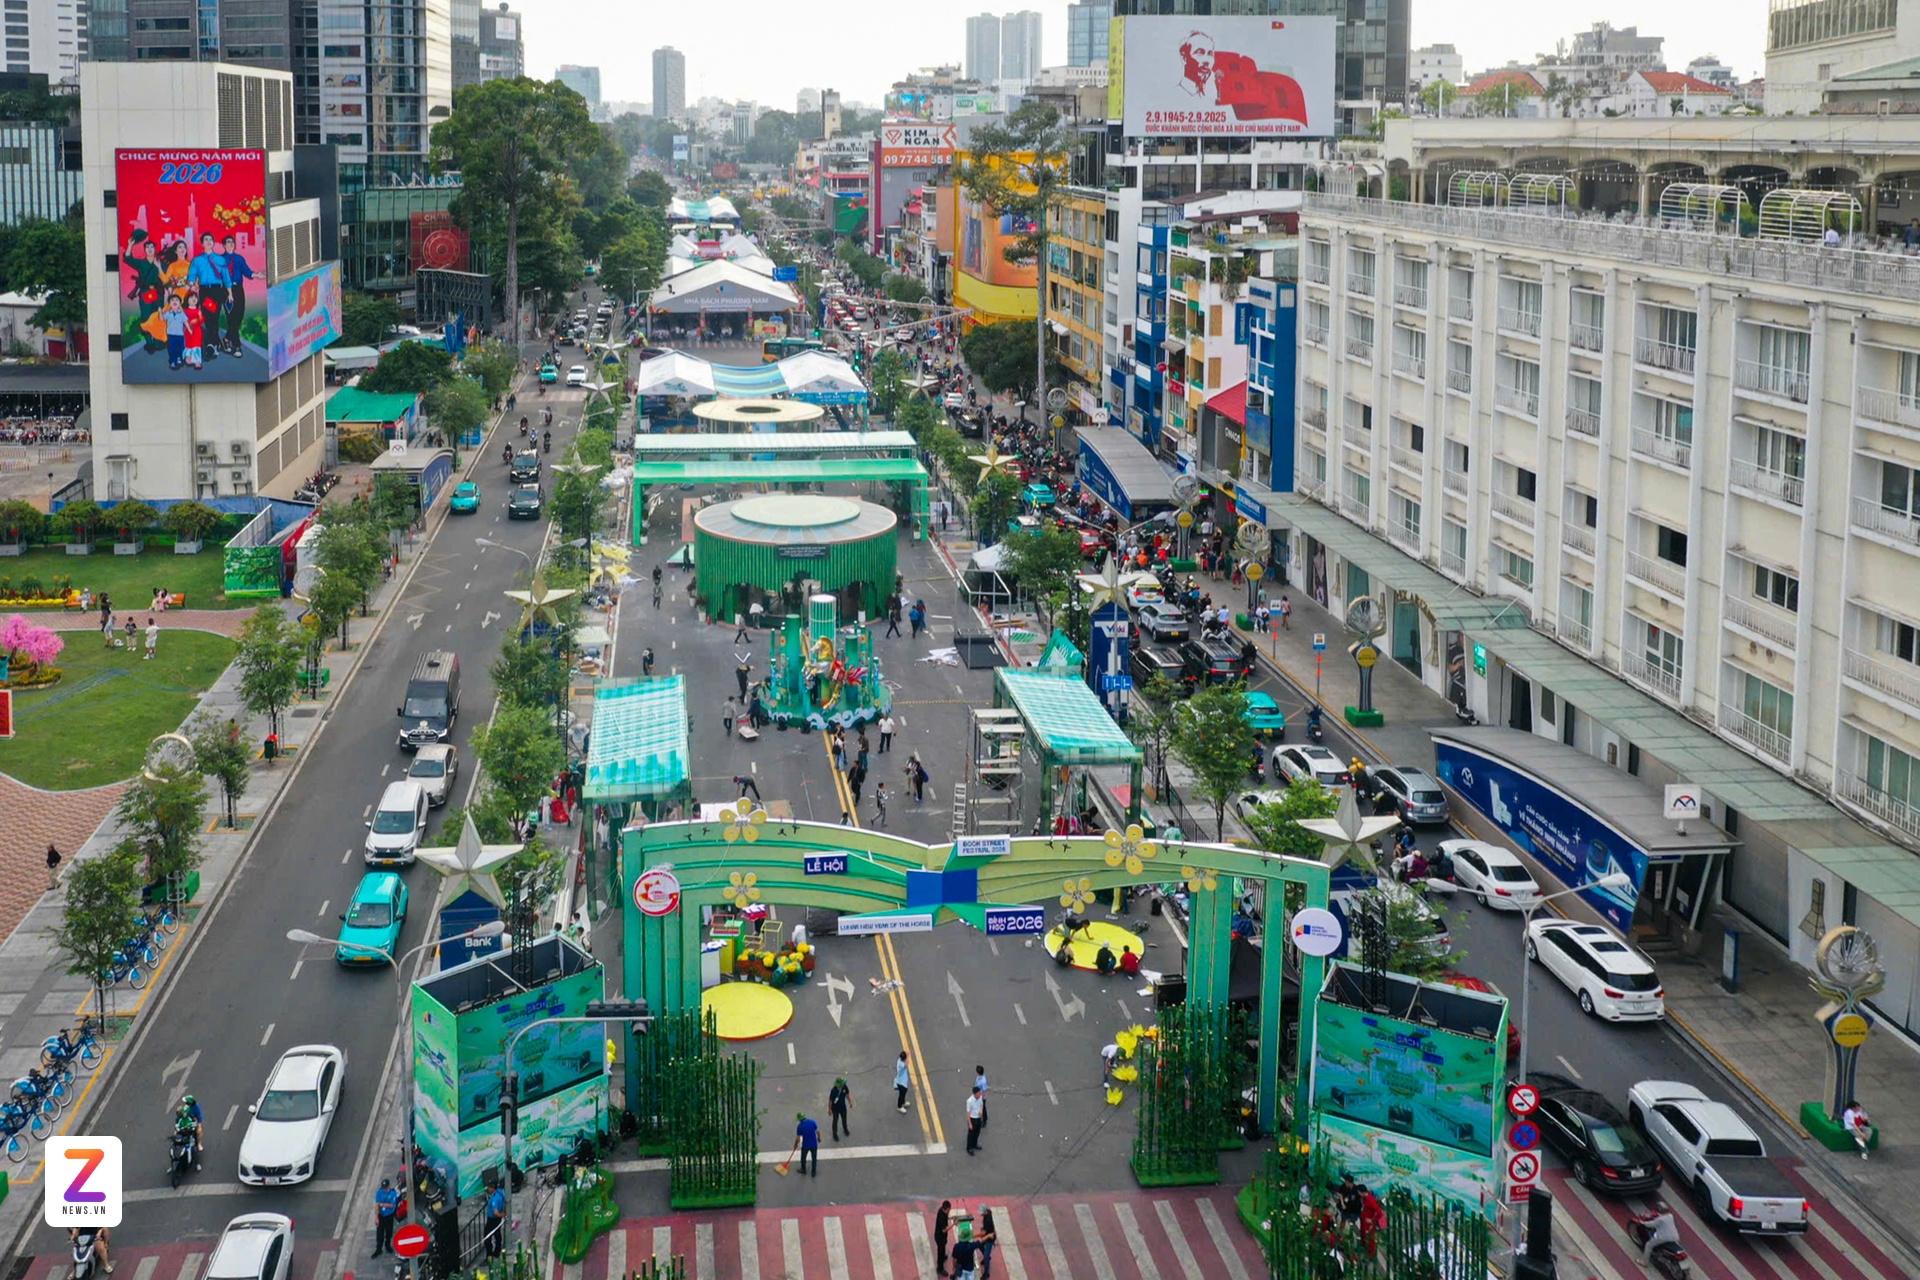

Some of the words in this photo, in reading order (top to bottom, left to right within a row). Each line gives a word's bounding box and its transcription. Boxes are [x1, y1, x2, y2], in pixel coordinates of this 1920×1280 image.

[1145, 111, 1227, 123] 2.9.1945-2.9.2025
[904, 129, 928, 137] KIM
[1287, 124, 1301, 133] NAM
[904, 138, 940, 146] NGAN
[119, 151, 157, 161] CHÚC
[884, 155, 898, 164] 09
[900, 155, 914, 164] 77
[914, 155, 928, 164] 44
[158, 162, 223, 184] 2026
[752, 296, 769, 304] NAM
[806, 857, 822, 873] LỄ
[823, 858, 844, 873] HỘI
[874, 922, 889, 930] YEAR
[910, 920, 931, 928] HORSE
[1006, 915, 1044, 931] 2026
[464, 937, 492, 948] Bank
